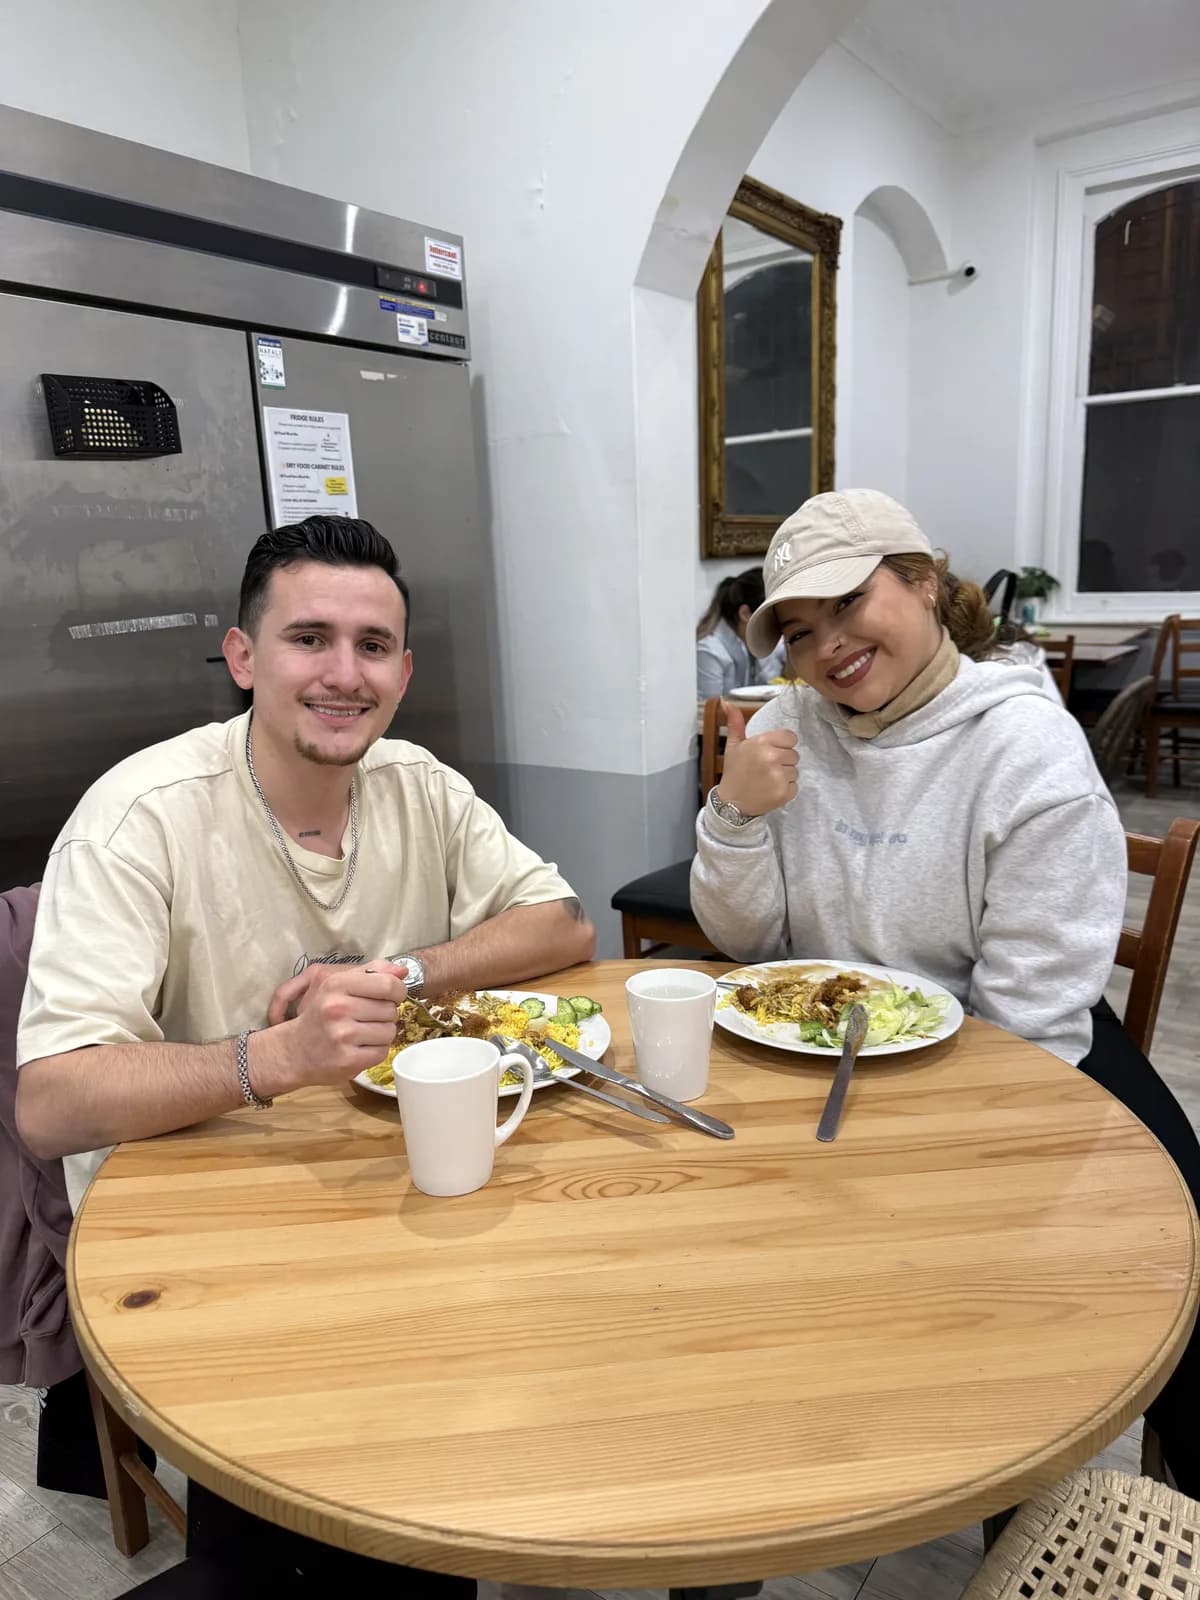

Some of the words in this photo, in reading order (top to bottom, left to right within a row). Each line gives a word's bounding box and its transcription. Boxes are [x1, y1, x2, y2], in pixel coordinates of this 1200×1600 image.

[290, 414, 307, 422] FRIDGE
[309, 415, 324, 423] RULES
[311, 463, 330, 471] CABINET
